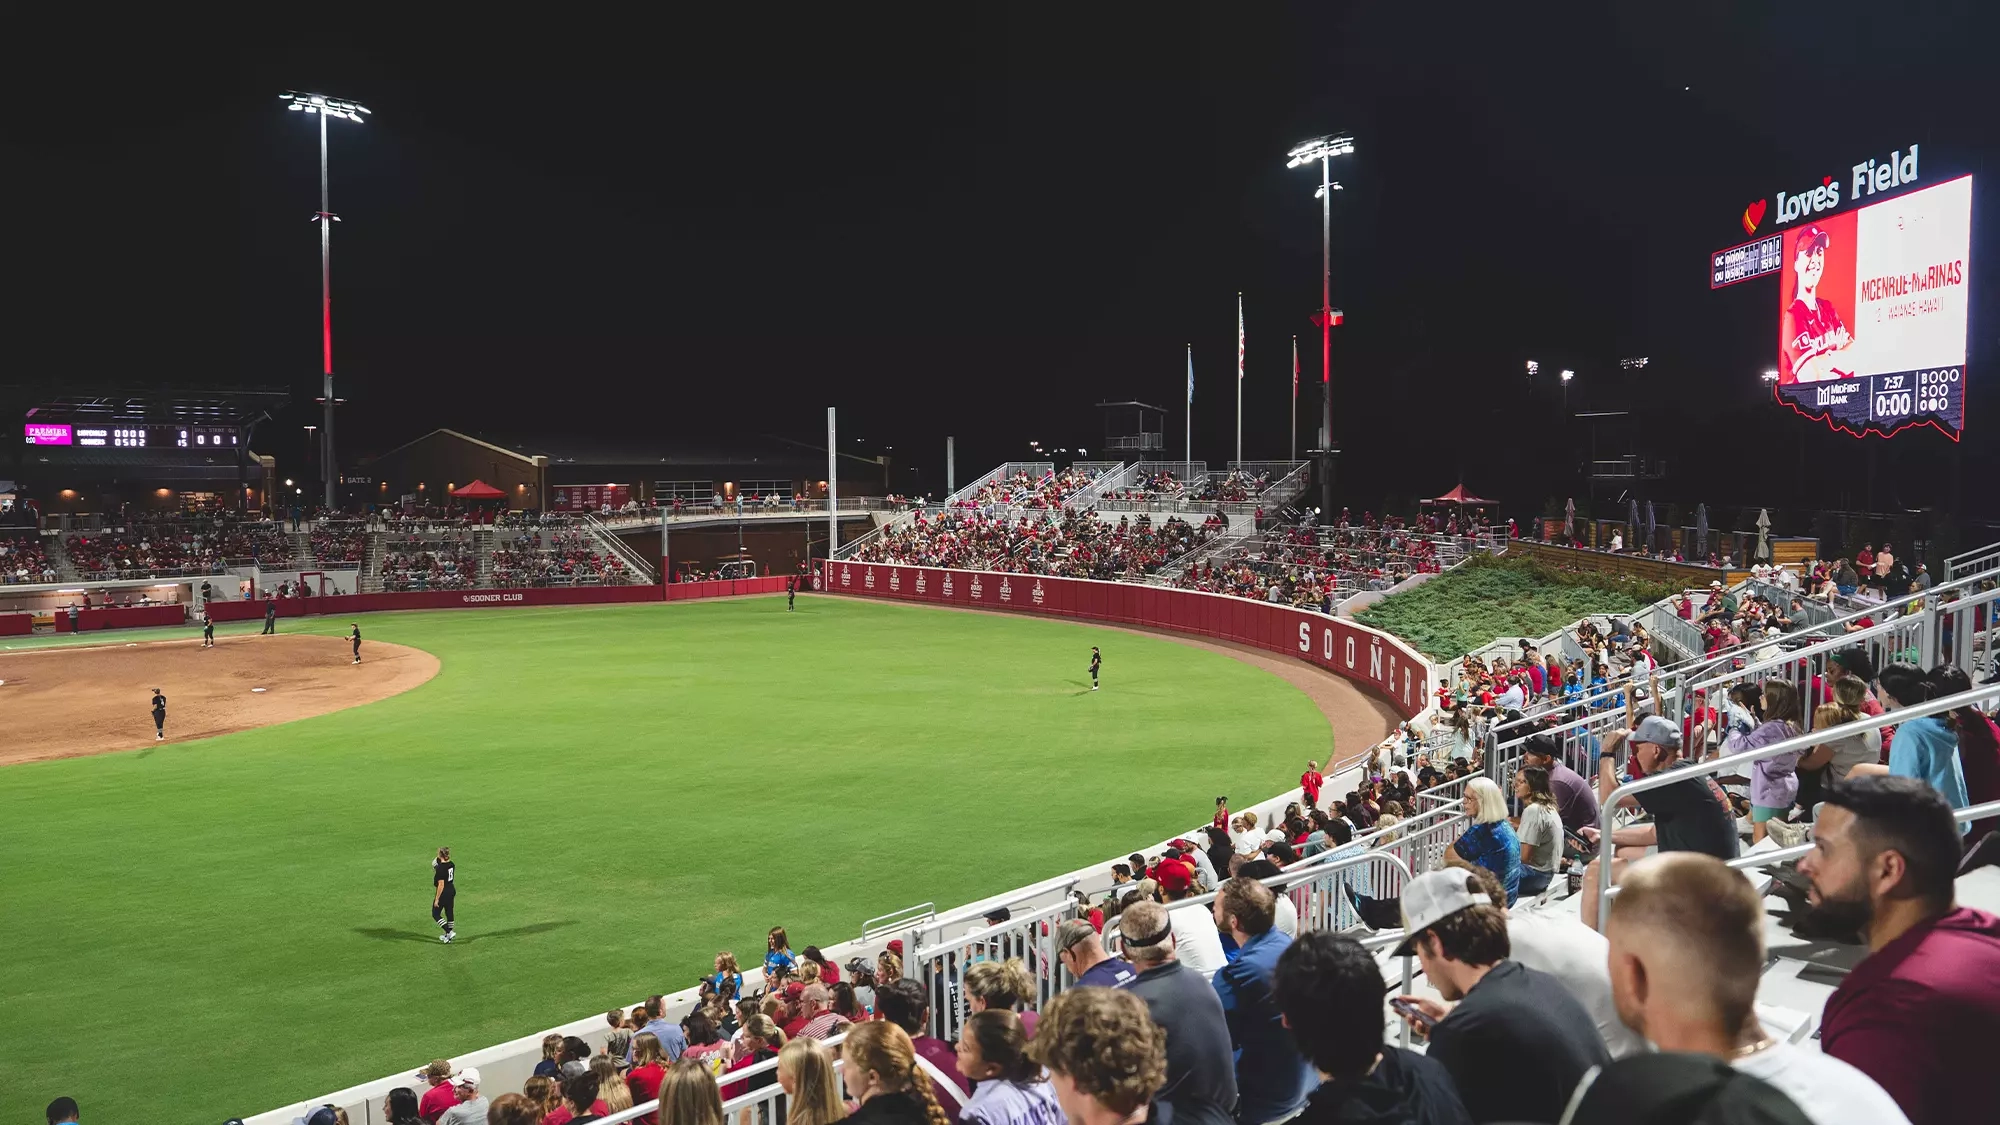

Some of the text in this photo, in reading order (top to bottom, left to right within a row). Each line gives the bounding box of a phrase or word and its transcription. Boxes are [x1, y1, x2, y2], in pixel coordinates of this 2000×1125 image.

[1851, 144, 1919, 200] Field
[1715, 255, 1724, 267] OC
[1762, 244, 1767, 254] 0
[1715, 272, 1724, 282] OU
[1775, 256, 1780, 266] 0
[1884, 376, 1904, 390] 7:37
[1922, 373, 1928, 384] B
[1921, 386, 1927, 397] S
[1830, 394, 1848, 404] BANK
[1876, 393, 1911, 416] 0:00
[29, 427, 67, 436] PREMIER
[114, 438, 121, 446] 0
[139, 438, 145, 446] 2
[197, 435, 236, 444] 0 0 1
